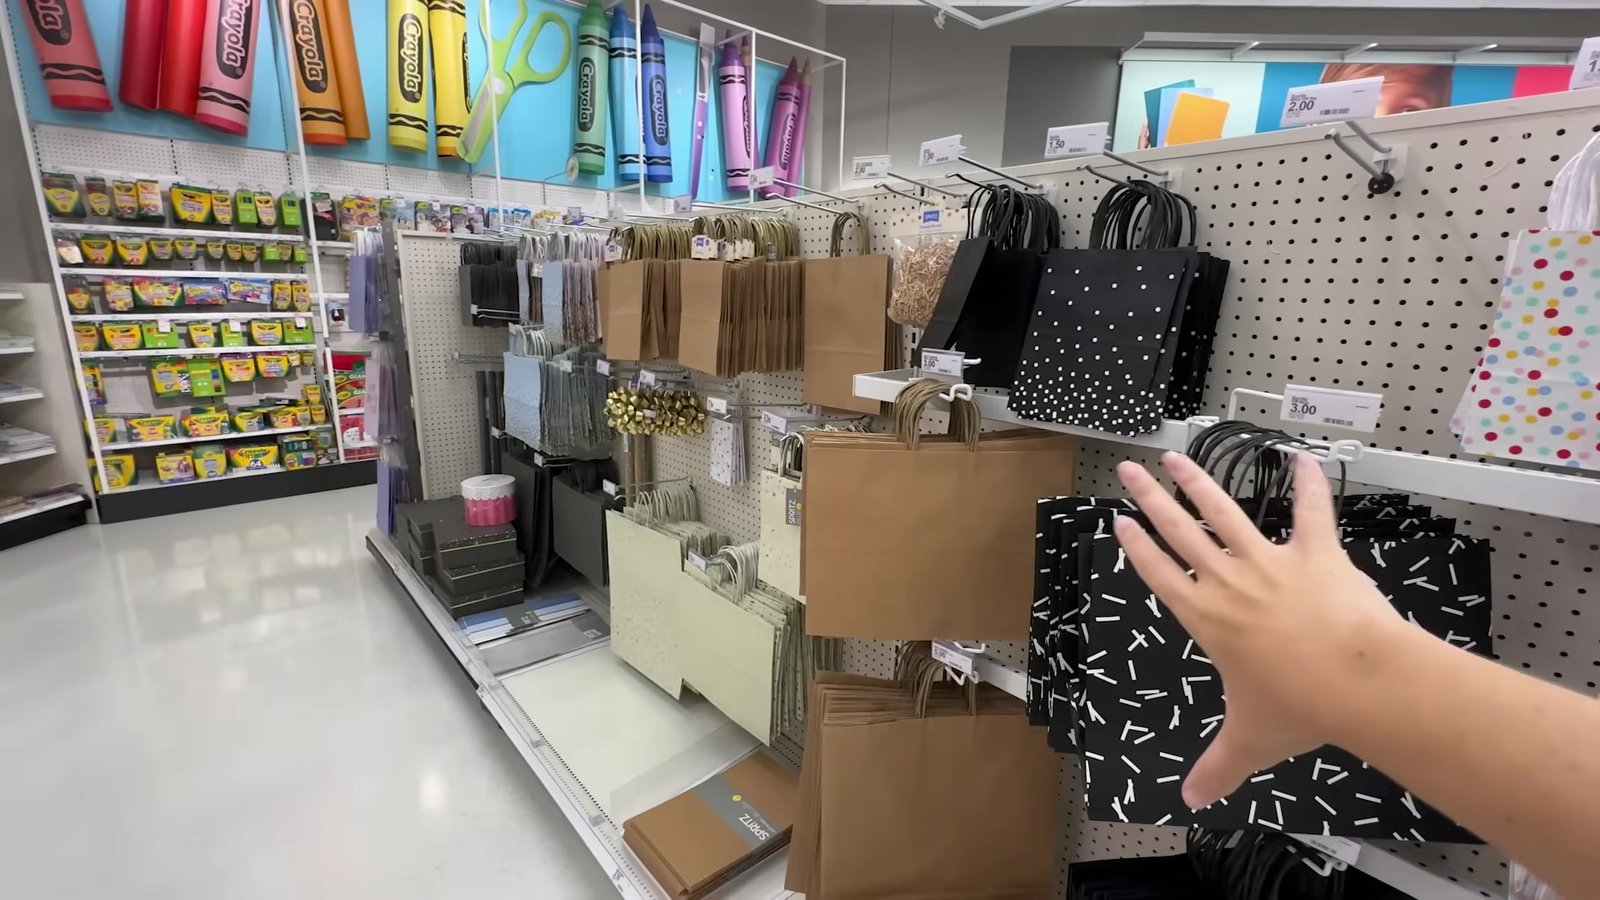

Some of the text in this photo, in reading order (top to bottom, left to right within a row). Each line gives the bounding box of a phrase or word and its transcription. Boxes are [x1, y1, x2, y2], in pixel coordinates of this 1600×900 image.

[294, 1, 324, 81] Crayola
[400, 19, 421, 92] Crayola
[578, 62, 594, 122] Crayola
[651, 79, 667, 137] Crayola
[1288, 100, 1314, 112] 2.00
[1049, 141, 1065, 150] 1.50
[923, 360, 936, 368] 3.00
[1290, 403, 1317, 415] 3.00
[788, 499, 797, 525] SPRITZ
[738, 813, 769, 841] SPRITZ
